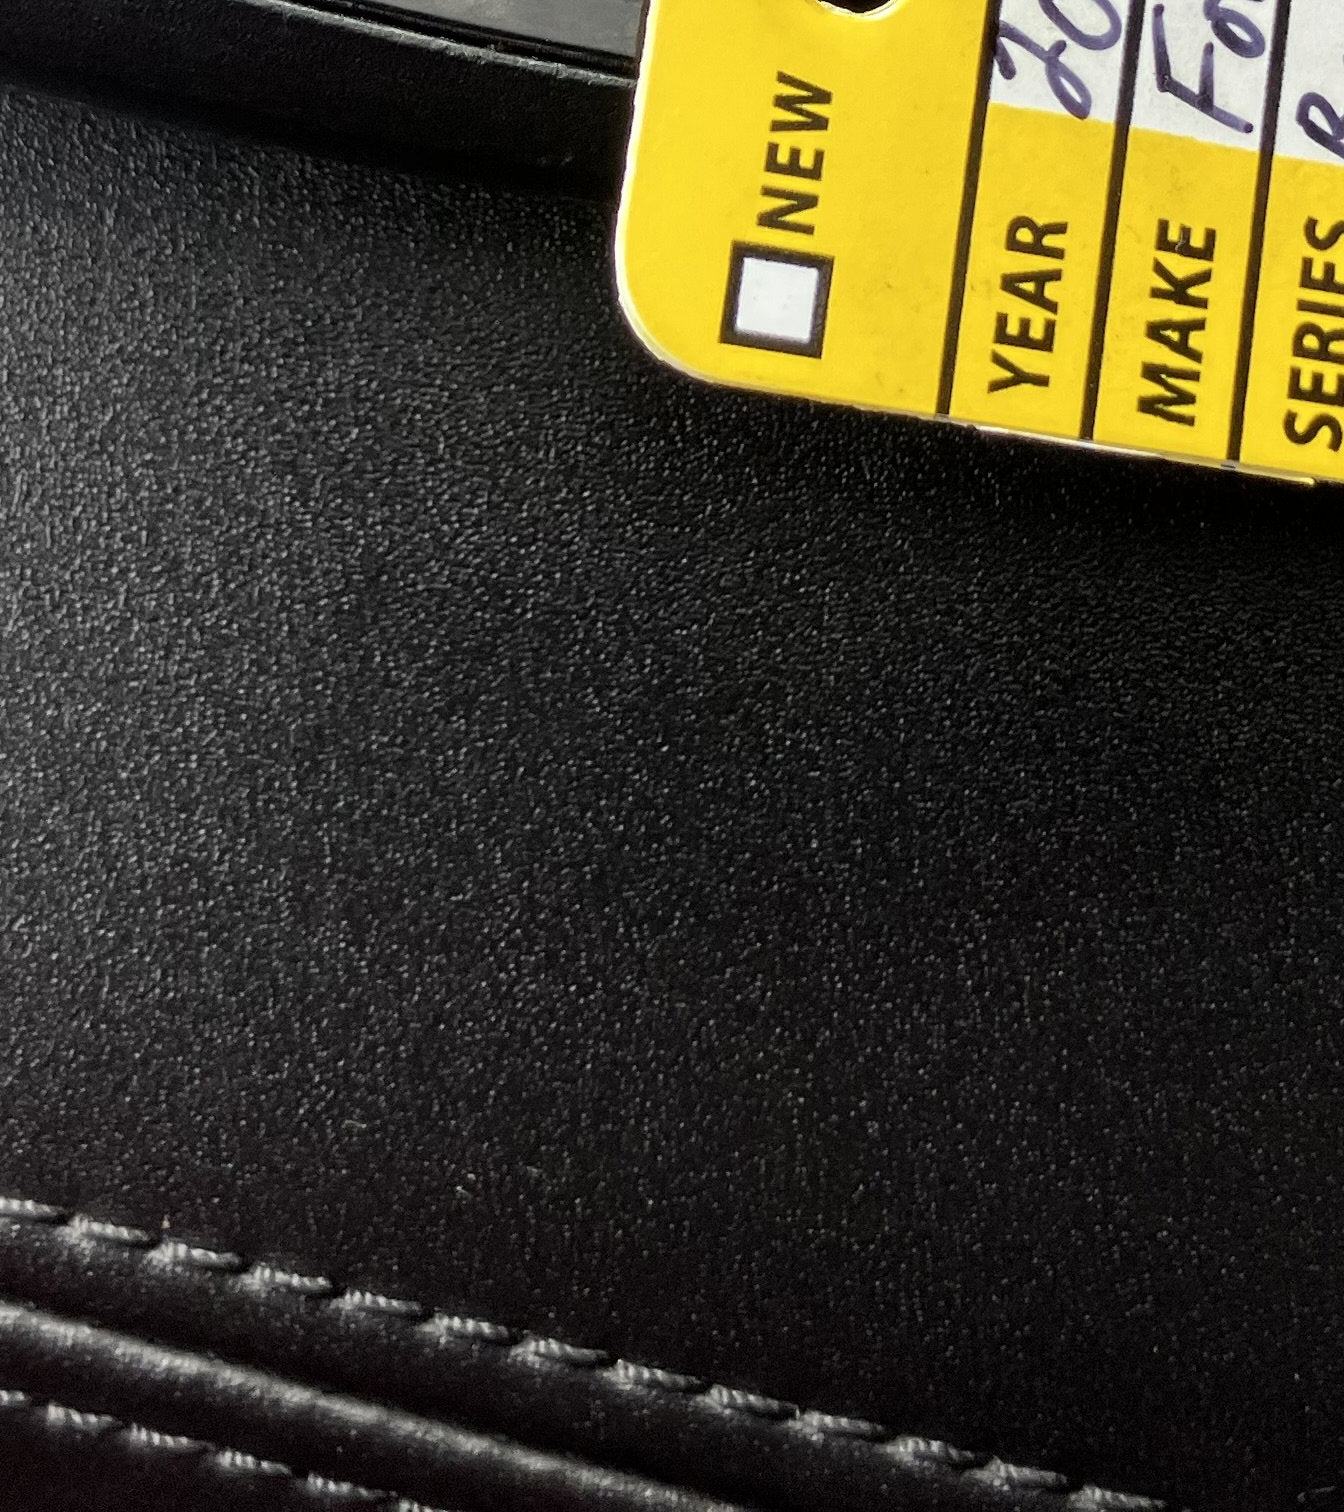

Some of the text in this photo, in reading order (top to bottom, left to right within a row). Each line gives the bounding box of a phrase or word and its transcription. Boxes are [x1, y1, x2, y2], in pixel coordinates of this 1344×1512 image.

[756, 72, 836, 238] NEW
[988, 212, 1068, 396] YEAR
[1138, 218, 1218, 428] MAKE
